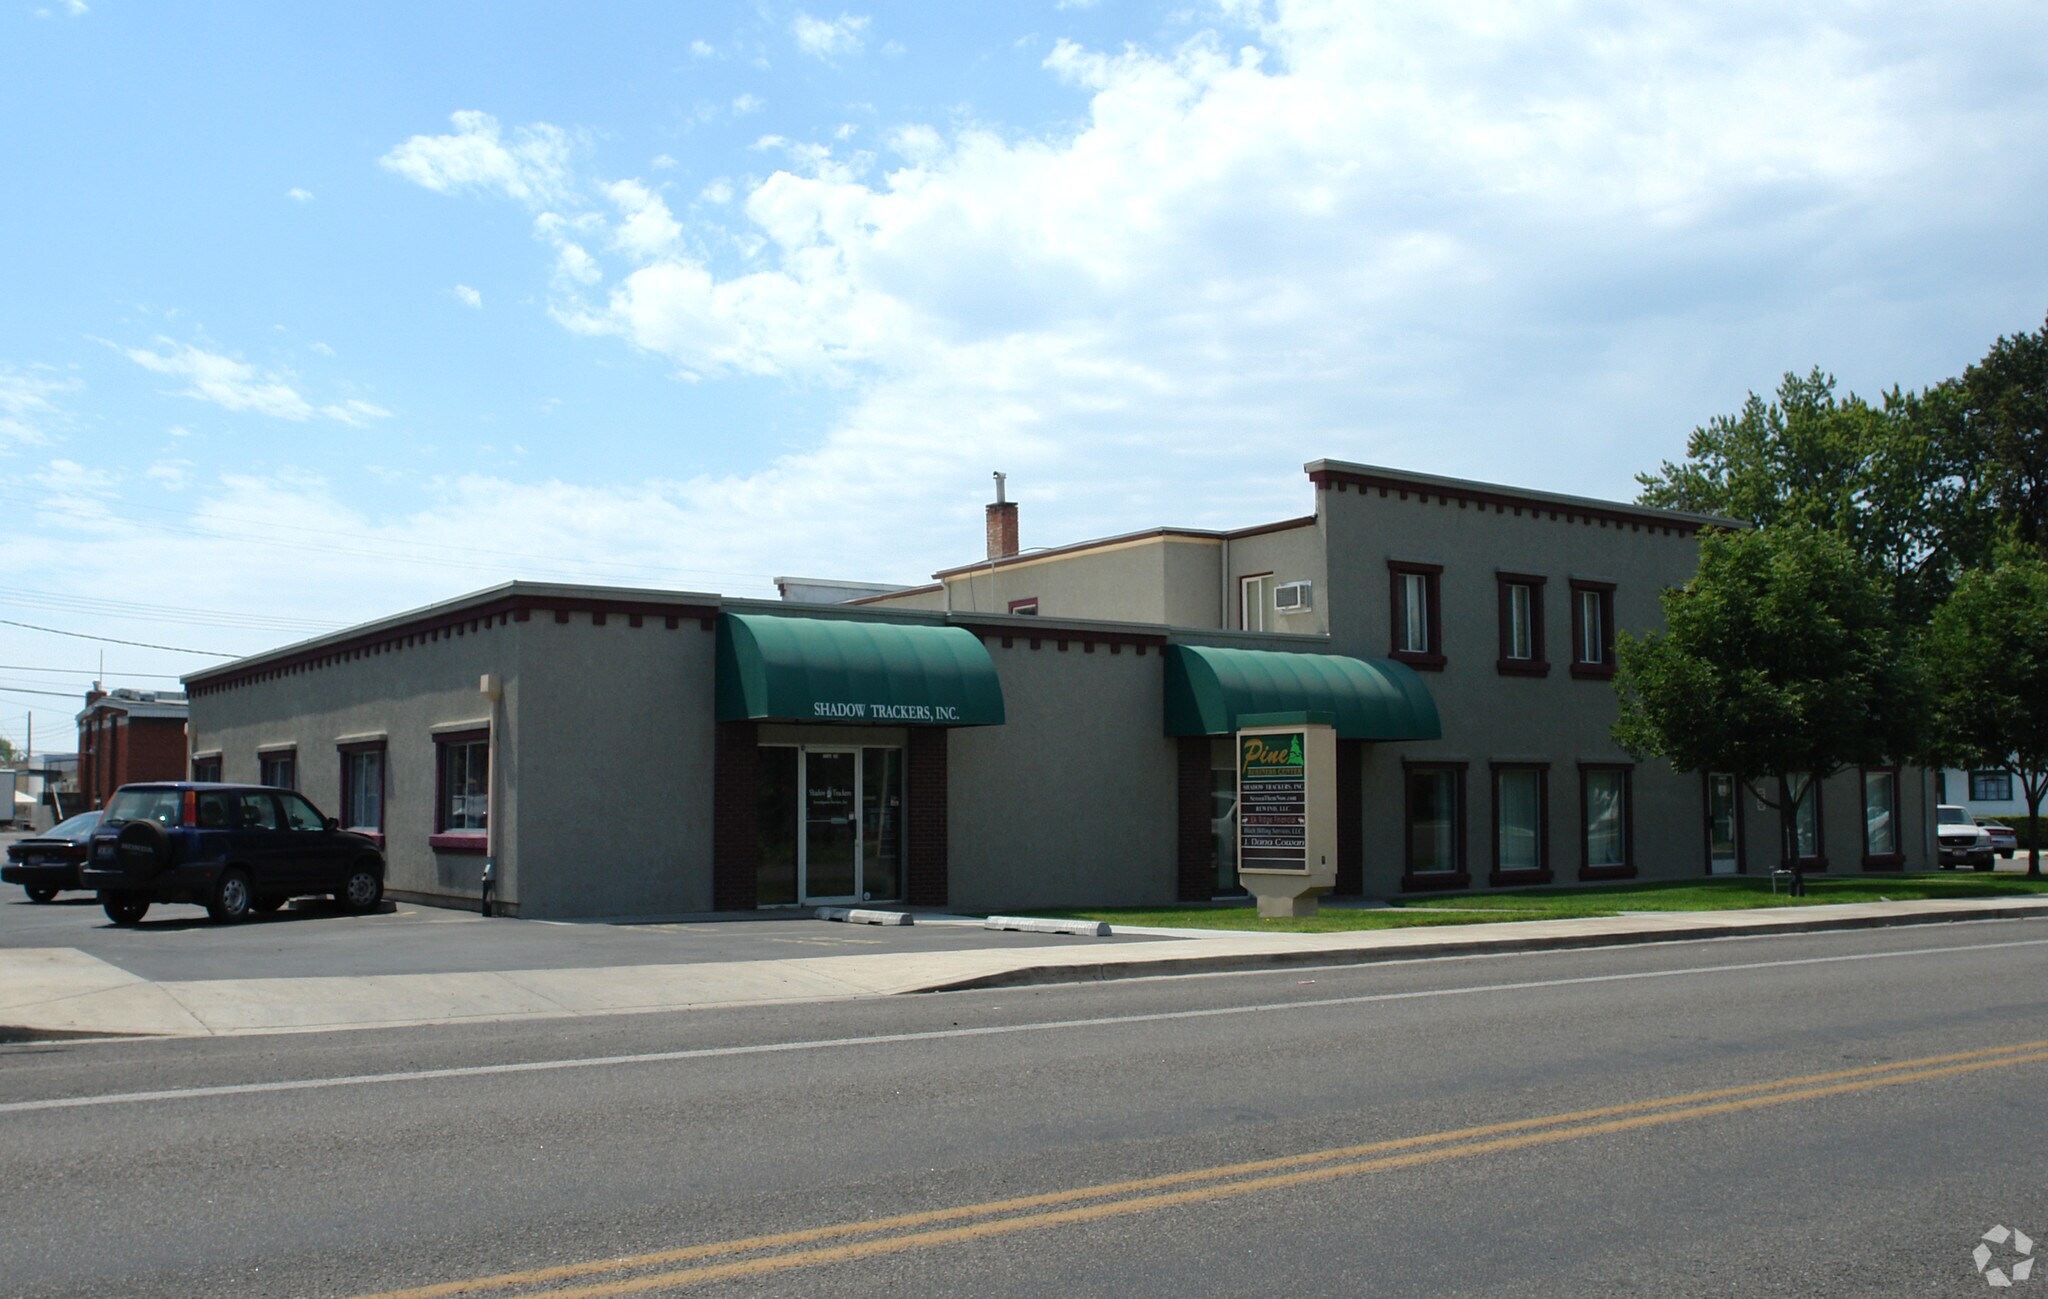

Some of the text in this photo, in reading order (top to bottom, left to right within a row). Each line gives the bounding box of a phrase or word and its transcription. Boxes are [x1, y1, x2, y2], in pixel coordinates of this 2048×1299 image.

[813, 702, 960, 722] SHADOW TRACKERS, INC.
[1242, 738, 1289, 774] Pine
[121, 842, 154, 854] HONDA
